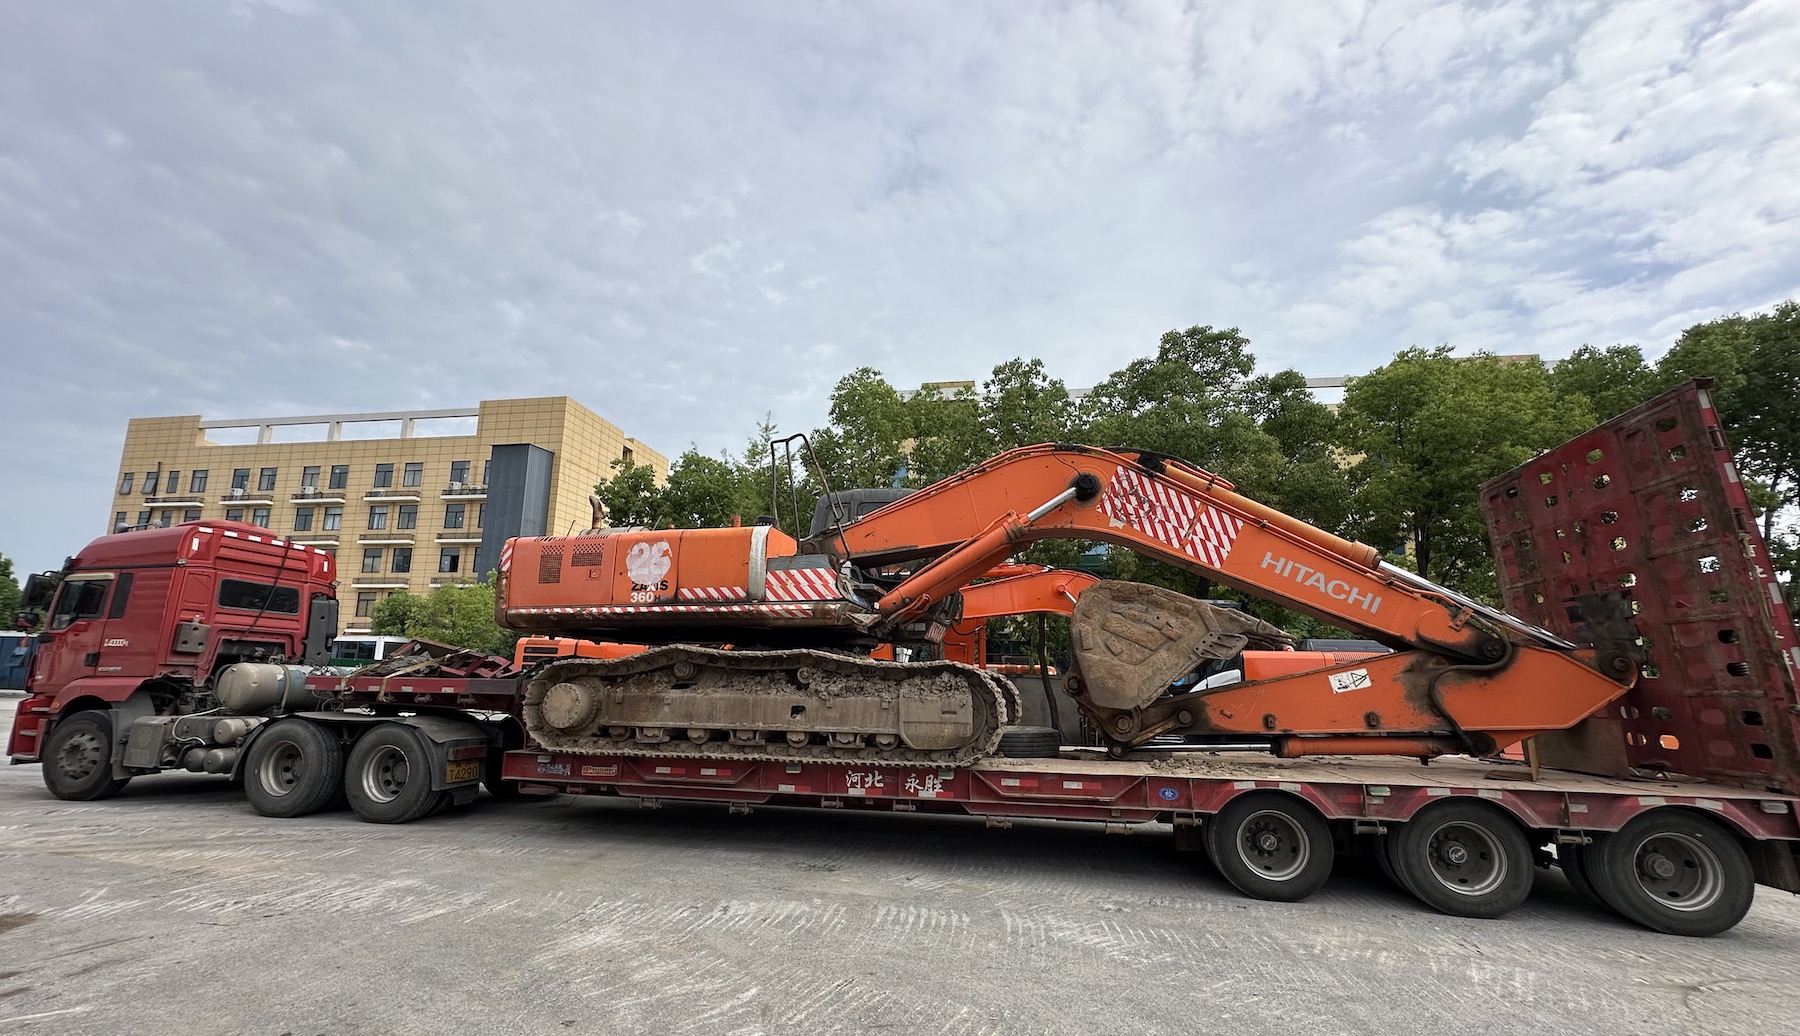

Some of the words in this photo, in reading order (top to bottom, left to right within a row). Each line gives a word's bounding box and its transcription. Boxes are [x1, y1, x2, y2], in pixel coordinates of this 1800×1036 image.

[1261, 551, 1382, 614] HITACHI
[448, 766, 478, 781] T4290
[845, 769, 884, 789] 河北
[904, 773, 944, 793] 永胜
